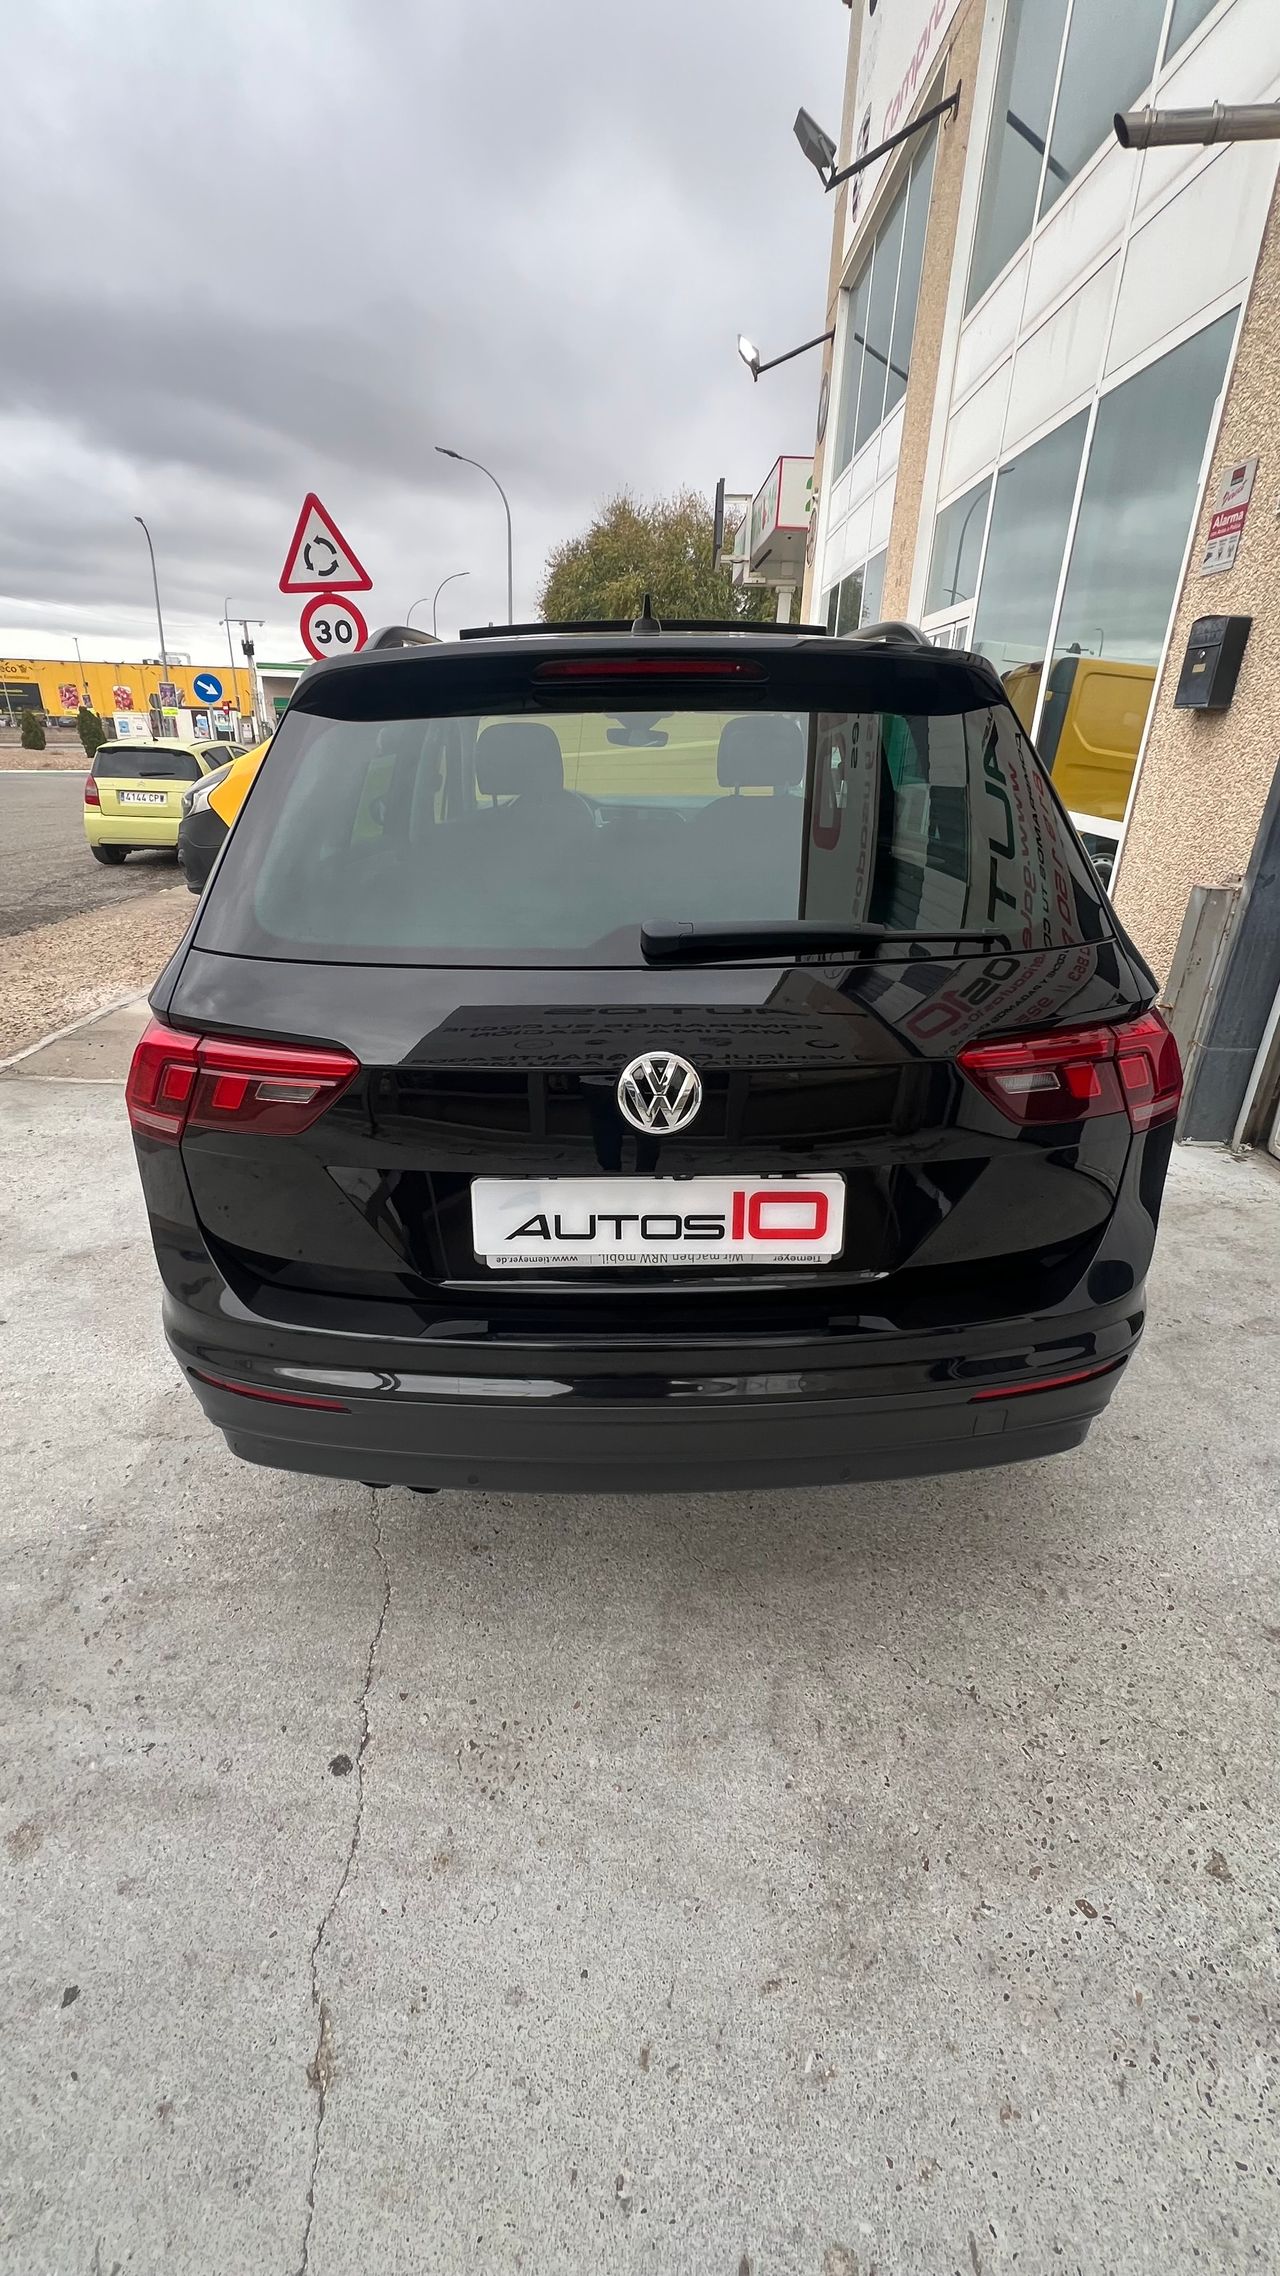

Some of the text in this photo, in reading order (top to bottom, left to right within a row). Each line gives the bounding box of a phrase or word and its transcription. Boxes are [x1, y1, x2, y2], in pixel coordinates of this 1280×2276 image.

[1212, 510, 1244, 529] Alarma
[315, 620, 353, 643] 30
[126, 792, 147, 802] 4144
[496, 1255, 579, 1264] www.tiemeyer.de
[639, 1254, 668, 1264] NRW
[672, 1254, 720, 1263] machen
[723, 1254, 744, 1262] Wir
[773, 1255, 822, 1263] Tiemeyer
